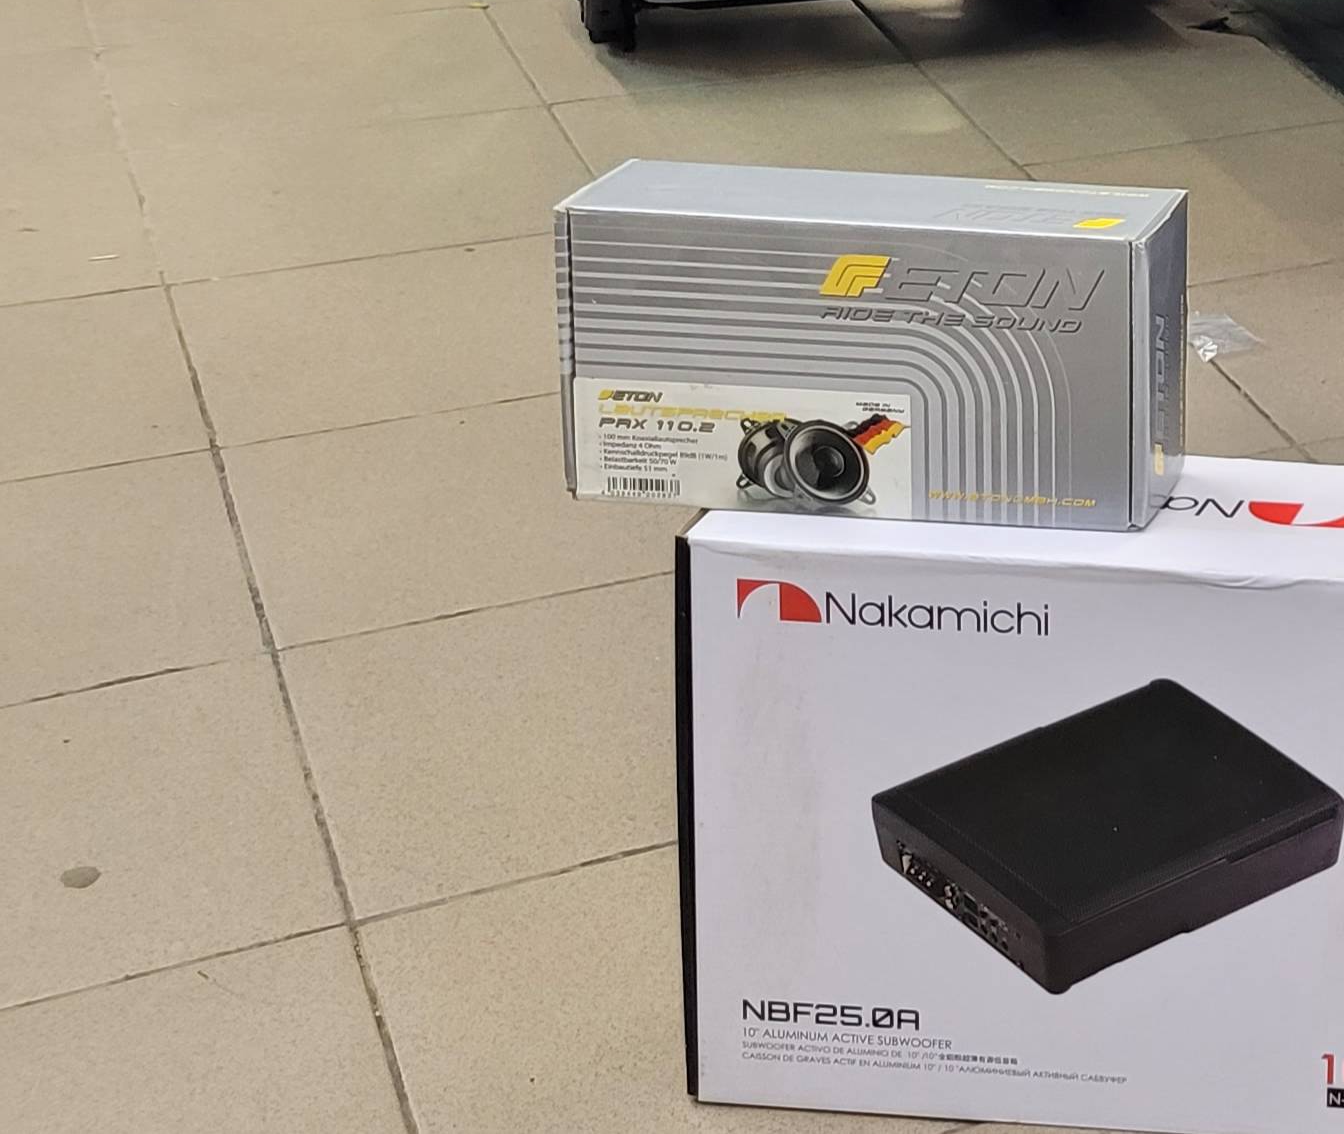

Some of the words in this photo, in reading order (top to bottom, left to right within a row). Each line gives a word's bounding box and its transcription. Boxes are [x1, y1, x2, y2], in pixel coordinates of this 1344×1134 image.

[886, 267, 1105, 311] ETON
[904, 310, 967, 327] THE
[971, 315, 1083, 334] SOUND
[611, 389, 663, 403] ETON
[657, 420, 716, 433] 110.2
[826, 591, 1050, 636] Nakamichi
[742, 999, 920, 1031] NBF25.0A
[742, 1040, 796, 1052] SUBWOOFER
[798, 1043, 831, 1054] ACTIVO
[833, 1047, 844, 1055] DE
[847, 1048, 889, 1058] ALUMINIO
[762, 1028, 828, 1042] ALUMINUM
[832, 1032, 874, 1045] ACTIVE
[877, 1036, 952, 1050] SUBWOOFER
[742, 1052, 781, 1062] CAISSON
[783, 1054, 795, 1062] DE
[796, 1055, 831, 1065] GRAVES
[833, 1057, 856, 1066] ACTIF
[859, 1059, 871, 1067] EN
